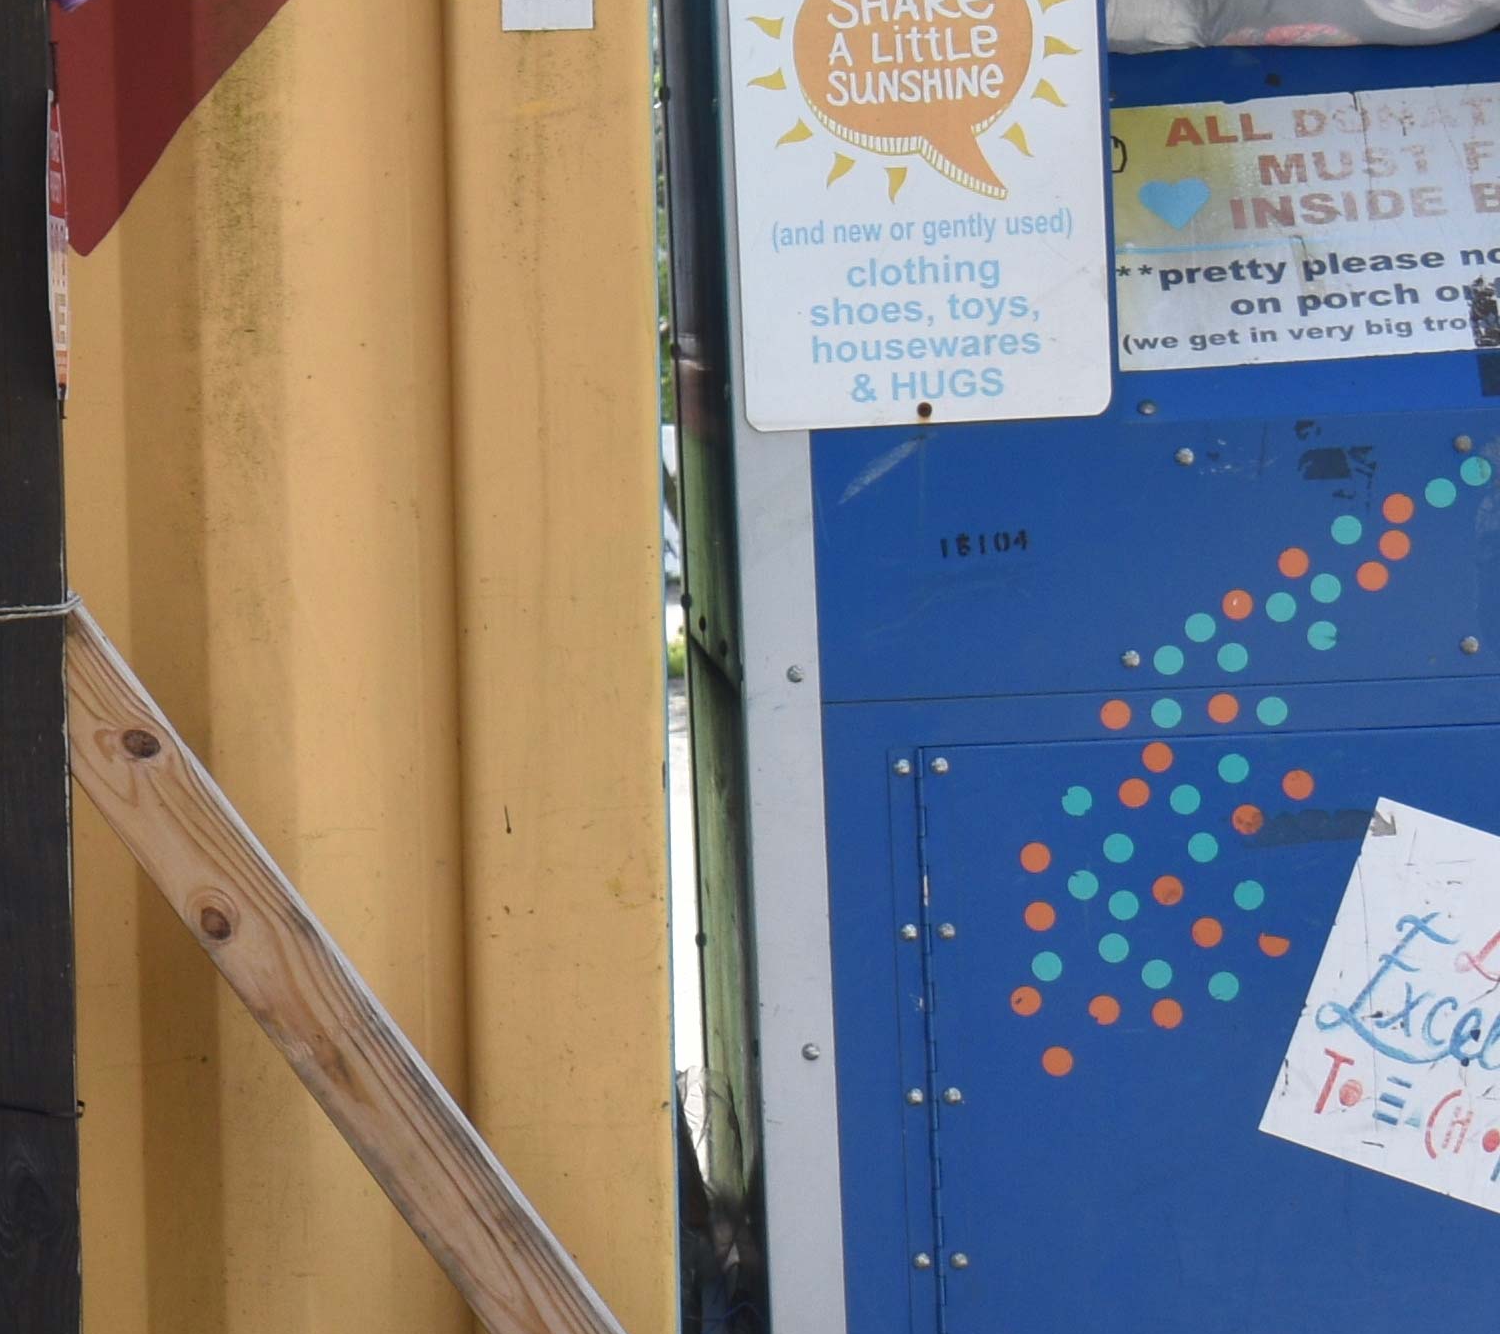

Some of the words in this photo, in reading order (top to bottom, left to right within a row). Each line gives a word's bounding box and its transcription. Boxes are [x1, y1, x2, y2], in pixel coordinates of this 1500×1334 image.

[829, 36, 853, 67] A
[1165, 113, 1273, 148] ALL
[1230, 186, 1447, 231] INSIDE
[772, 220, 824, 254] (and
[833, 220, 880, 244] new
[890, 219, 914, 242] or
[922, 212, 997, 244] gently
[1006, 208, 1073, 237] used)
[847, 255, 1001, 291] clothing
[1302, 247, 1445, 282] please
[810, 295, 934, 329] shoes,
[947, 293, 1041, 325] toys,
[1230, 296, 1281, 316] on
[1299, 282, 1420, 317] porch
[811, 329, 1041, 365] housewares
[1122, 331, 1180, 356] (we
[1190, 330, 1239, 352] get
[1250, 325, 1277, 345] in
[1288, 321, 1355, 344] very
[1366, 315, 1413, 340] big
[850, 374, 877, 403] &
[891, 366, 1004, 403] HUGS
